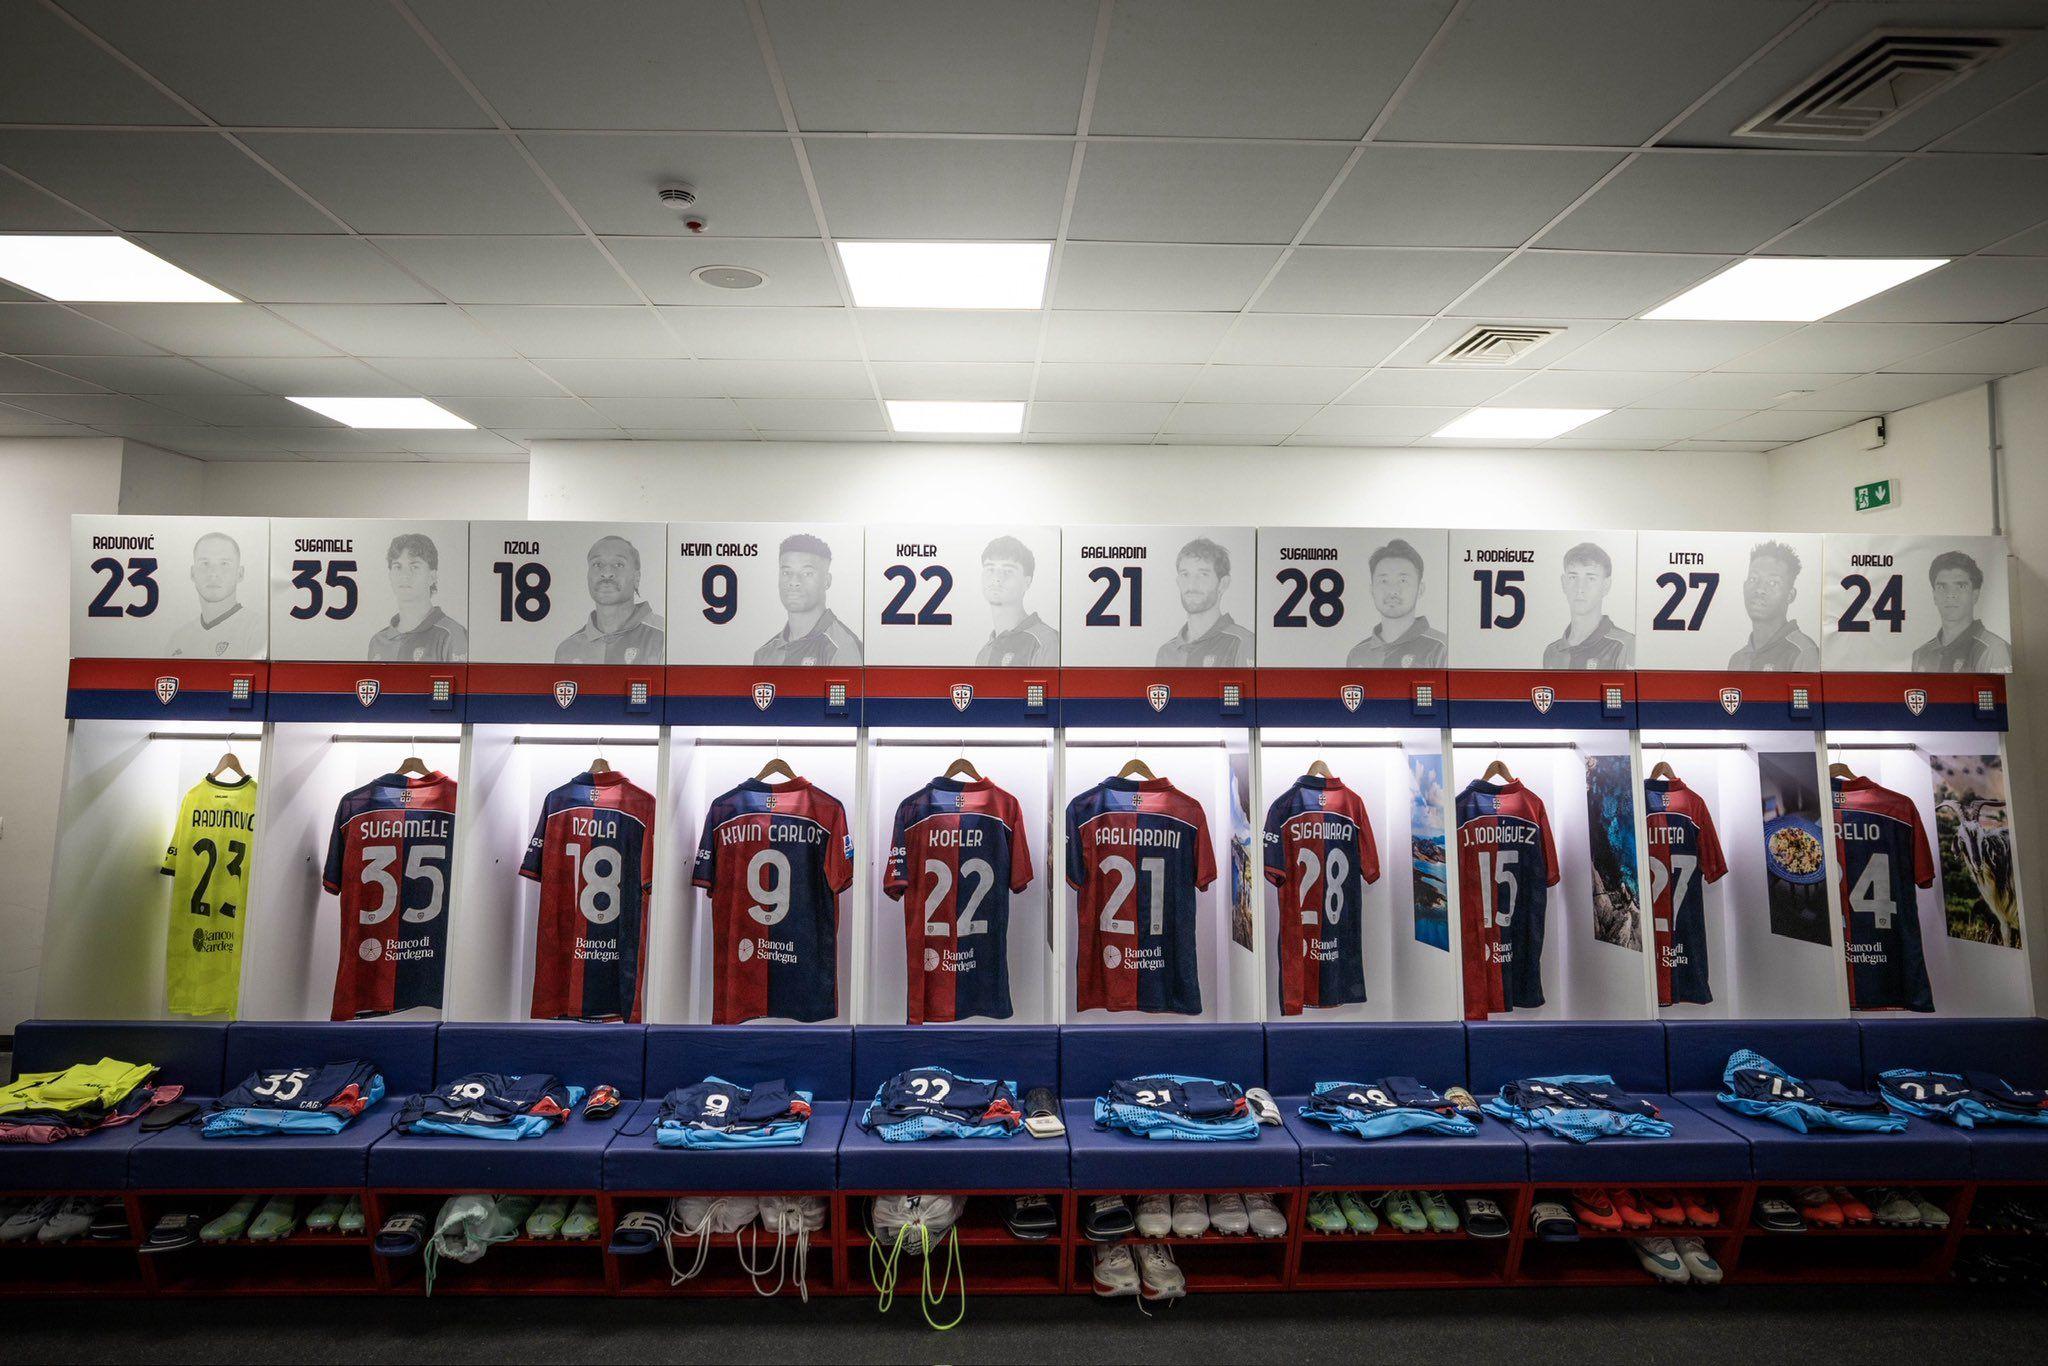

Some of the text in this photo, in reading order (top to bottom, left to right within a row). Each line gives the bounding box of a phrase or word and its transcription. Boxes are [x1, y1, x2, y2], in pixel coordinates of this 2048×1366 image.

[93, 535, 154, 550] RADUNOVIĆ
[295, 539, 352, 552] SUGAMELE
[504, 541, 539, 554] NZOLA
[681, 543, 758, 557] KEVIN CARLOS
[897, 544, 936, 557] KOFLER
[1082, 546, 1147, 559] GAGLIARDINI
[1280, 548, 1337, 561] SUGAWARA
[1464, 546, 1534, 563] J. RODRÍGUEZ
[1669, 552, 1704, 565] LITETA
[1852, 555, 1893, 567] AURELIO
[88, 557, 159, 618] 23
[290, 560, 358, 620] 35
[493, 562, 551, 622] 18
[702, 564, 738, 625] 9
[881, 564, 953, 625] 22
[1085, 566, 1142, 627] 21
[1273, 567, 1345, 628] 28
[1473, 569, 1525, 630] 15
[1653, 572, 1720, 631] 27
[1838, 573, 1906, 633] 24
[360, 820, 448, 840] SUGAMELE
[572, 817, 616, 838] NZOLA
[722, 824, 822, 846] KEVIN CARLOS
[1649, 827, 1684, 844] LITETA
[929, 829, 982, 847] KOFLER
[1095, 827, 1181, 849] GAGLIARDINI
[1464, 829, 1474, 846] J.
[359, 845, 446, 925] 35
[566, 843, 622, 924] 18
[747, 849, 791, 925] 9
[1297, 848, 1349, 925] 28
[1479, 850, 1518, 928] 15
[925, 858, 994, 937] 22
[1099, 855, 1165, 935] 21
[1649, 855, 1697, 932] 27
[387, 937, 430, 949] Banco di
[576, 938, 616, 948] Banco di
[758, 938, 794, 951] Banco di
[1125, 946, 1162, 958] Banco di
[1873, 942, 1882, 952] di
[385, 949, 434, 961] Sardegna
[574, 948, 619, 962] Sardegna
[757, 949, 797, 964] Sardegna
[943, 950, 968, 960] Banco
[1124, 958, 1165, 970] Sardegna
[254, 1071, 310, 1100] 35
